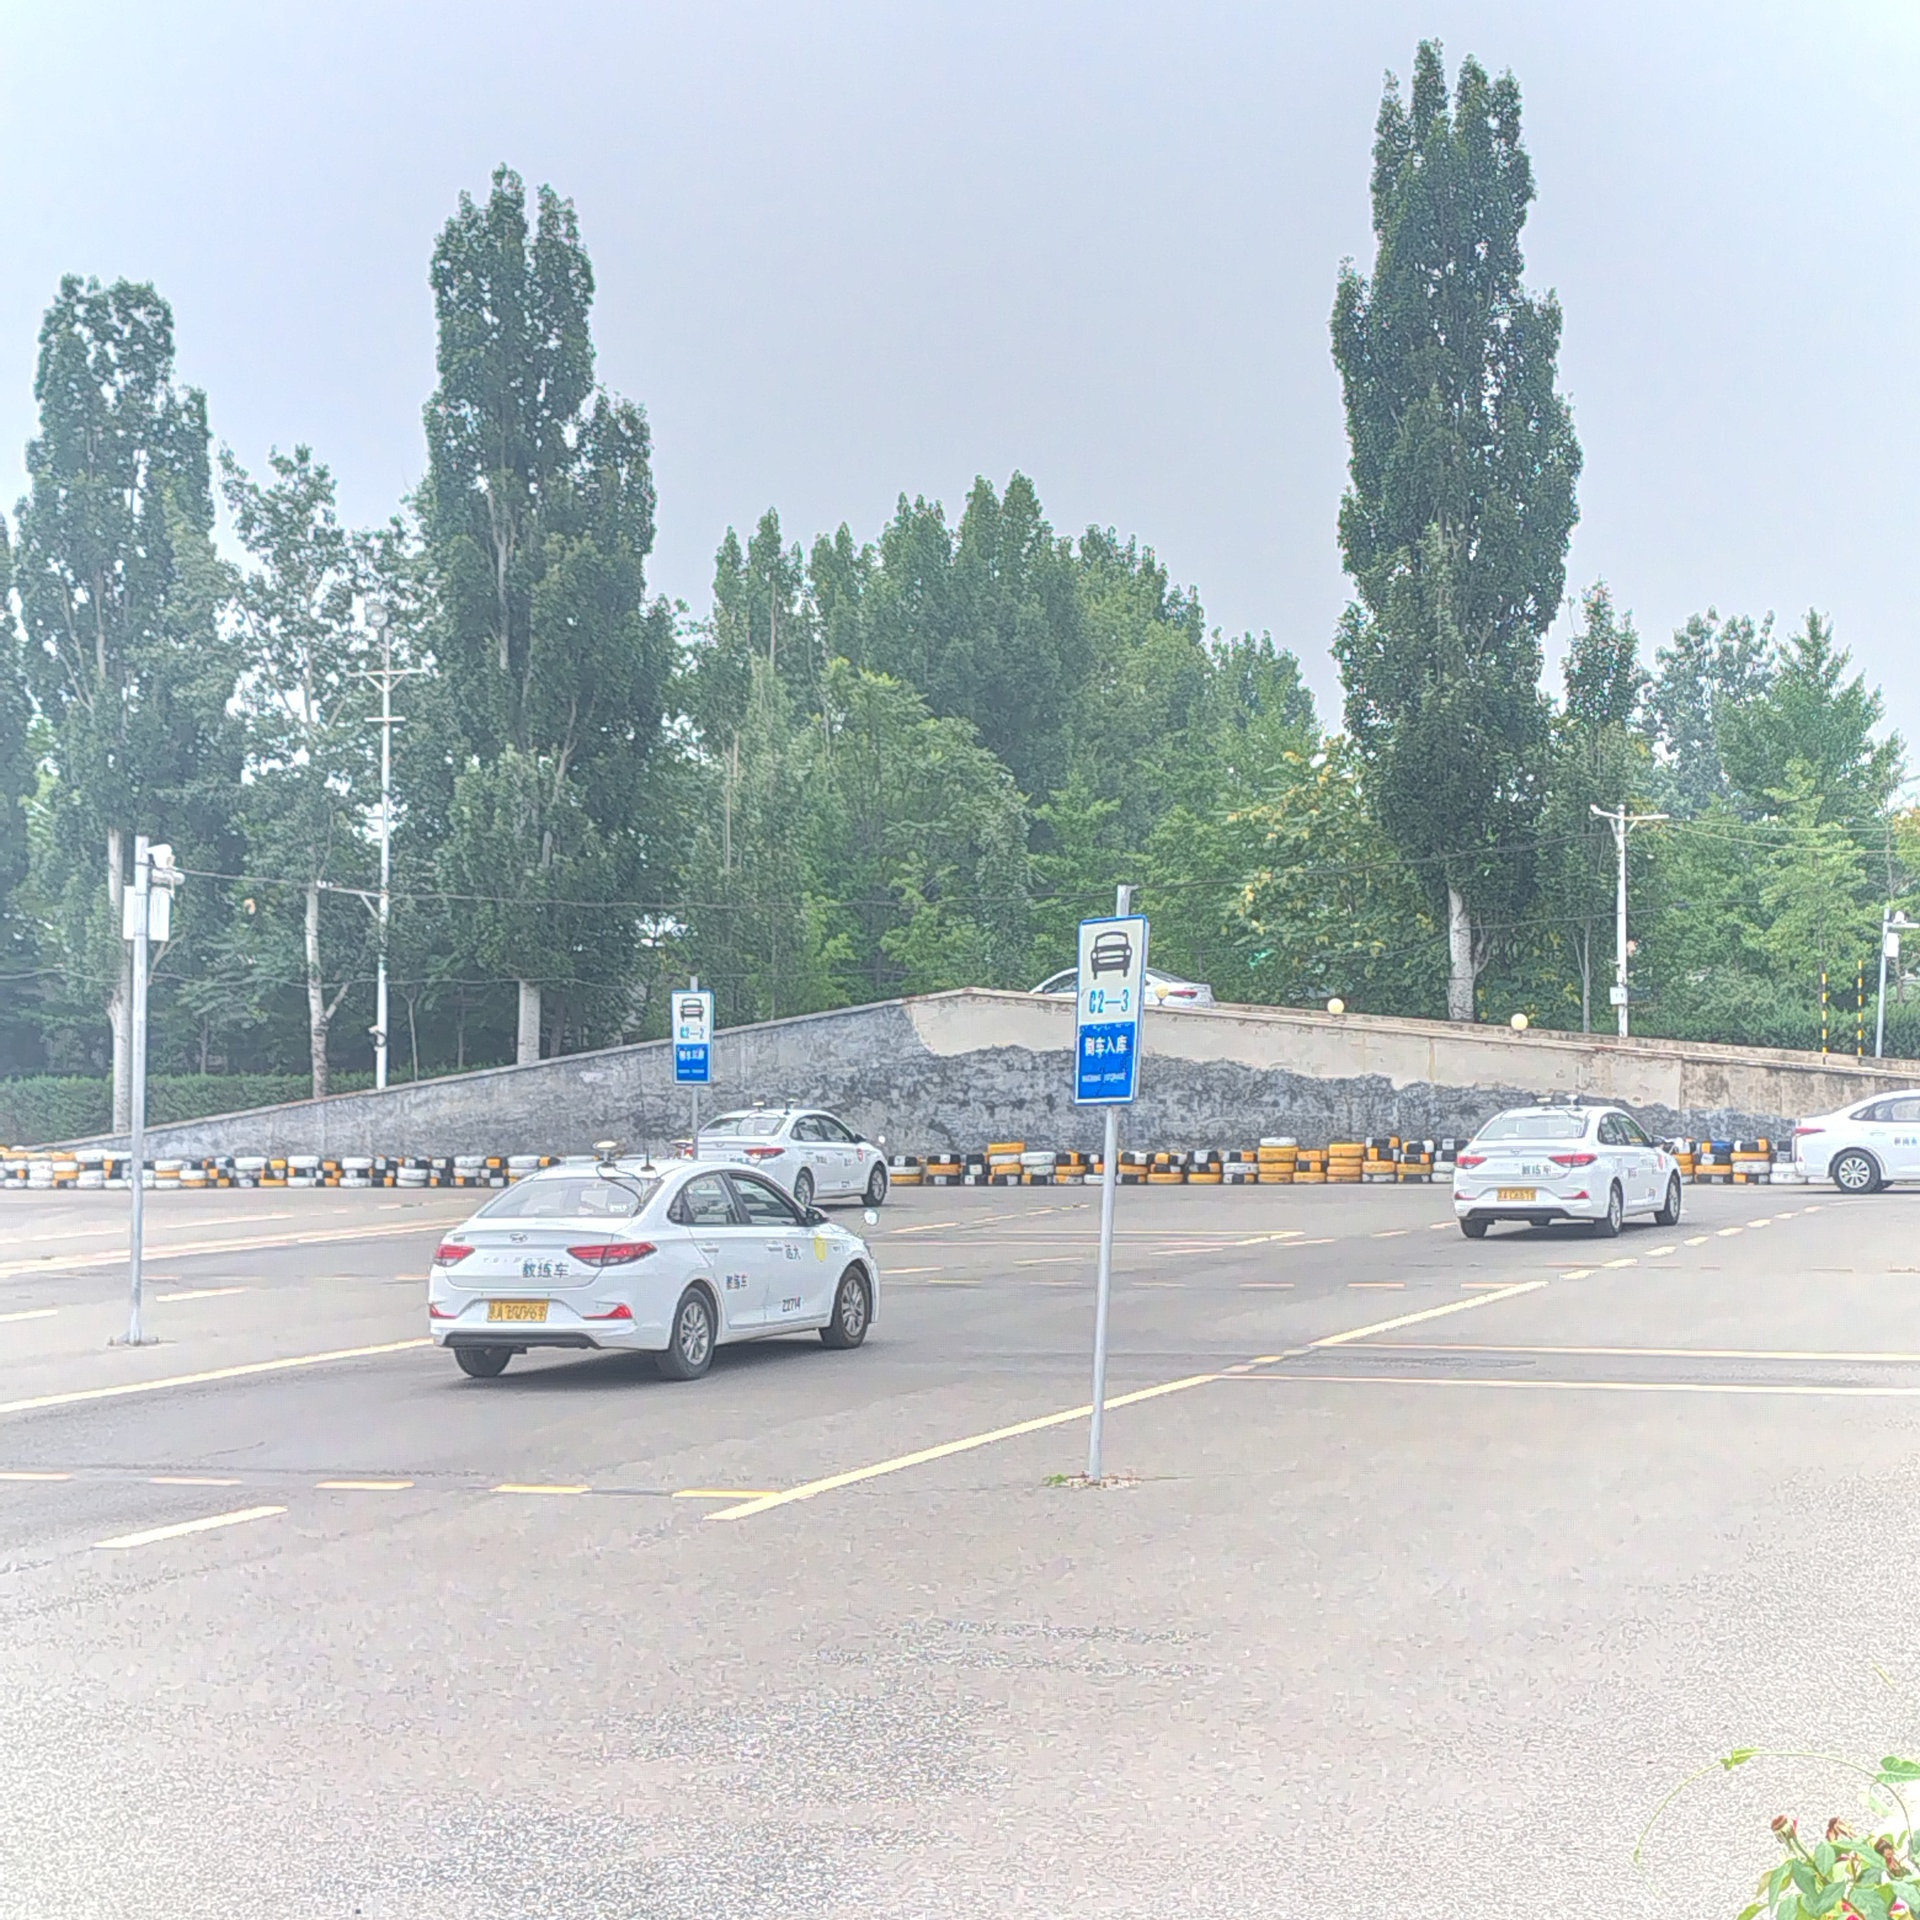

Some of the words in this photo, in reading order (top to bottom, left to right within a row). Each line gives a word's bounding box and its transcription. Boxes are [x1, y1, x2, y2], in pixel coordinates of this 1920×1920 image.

[1085, 1035, 1128, 1058] 倒车入库
[523, 1261, 569, 1278] 教练车
